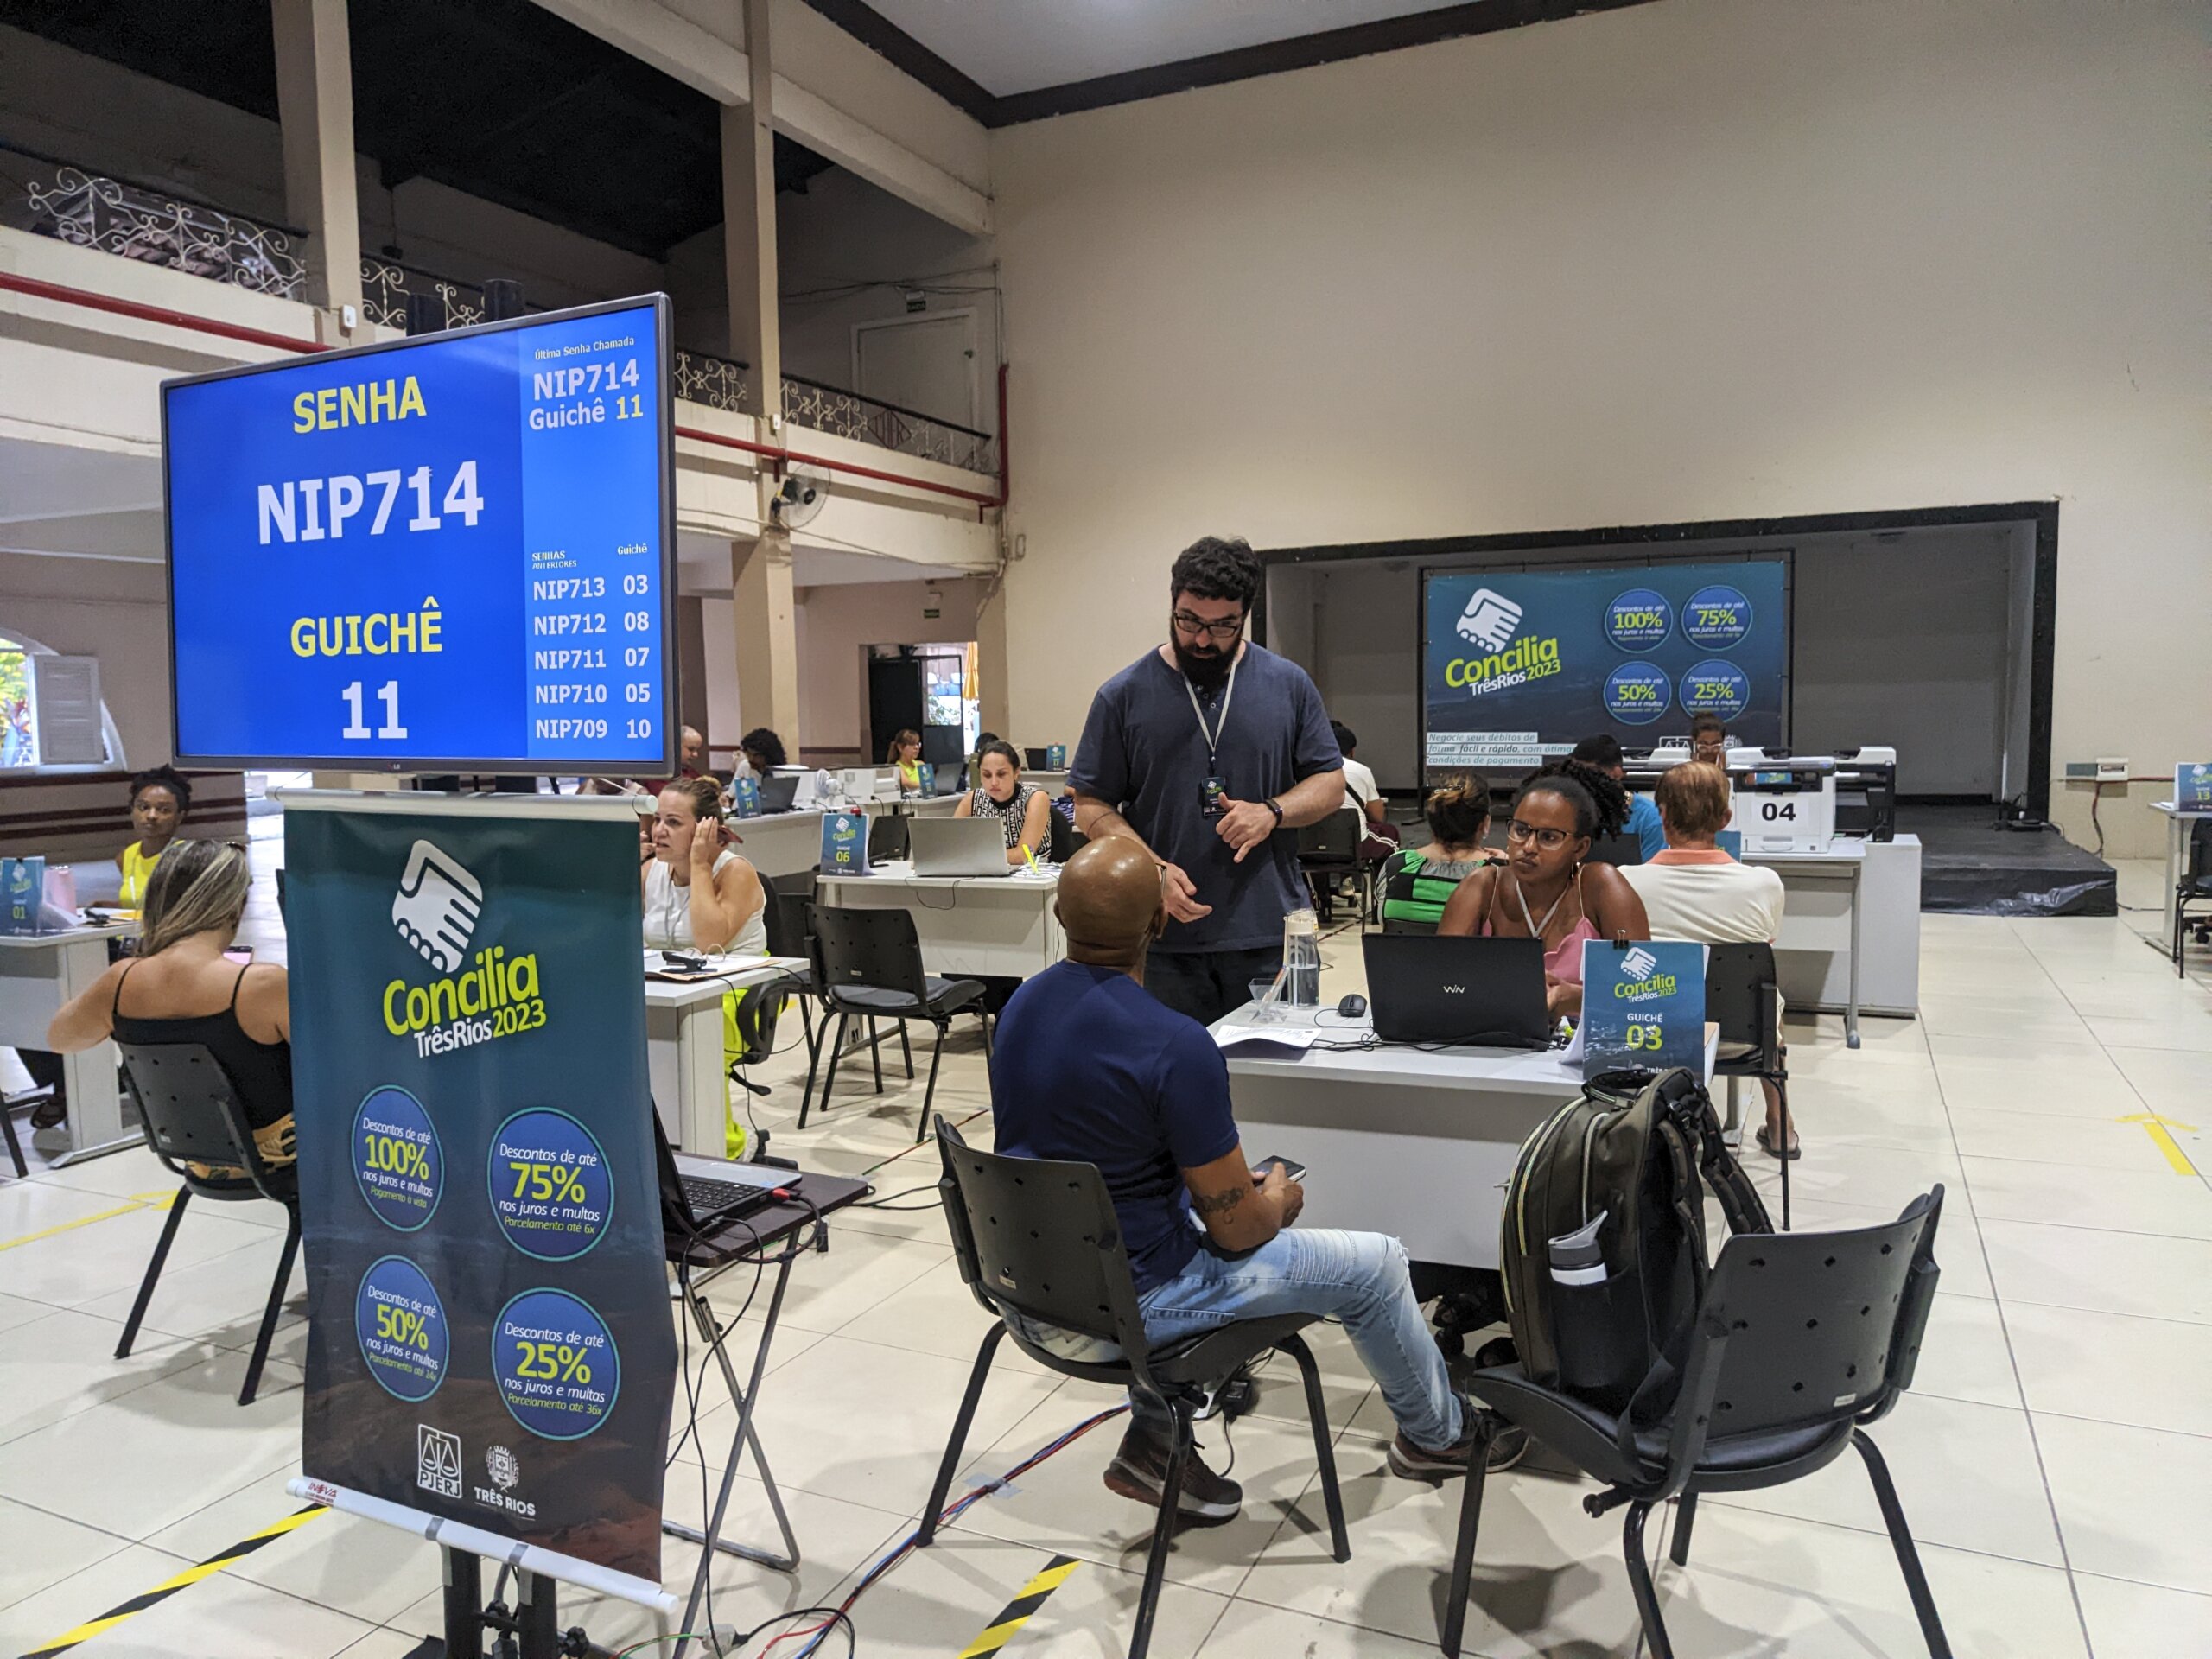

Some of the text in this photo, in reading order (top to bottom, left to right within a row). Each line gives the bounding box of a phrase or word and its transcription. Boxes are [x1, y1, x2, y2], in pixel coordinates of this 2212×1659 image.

[535, 335, 634, 360] Última Senha Chamada
[533, 359, 639, 401] NIP714
[292, 375, 427, 433] SENHA
[529, 394, 644, 430] Guichê 11
[257, 460, 484, 544] NIP714
[531, 550, 566, 562] SENHAS
[617, 543, 648, 556] Guichê
[531, 560, 577, 570] ANTERIORES
[533, 576, 606, 601] NIP713
[623, 574, 648, 595] 03
[290, 596, 442, 657] GUICHÊ
[534, 613, 607, 636] NIP712
[624, 611, 650, 632] 08
[1614, 612, 1662, 629] 100%
[1697, 608, 1737, 626] 75%
[534, 649, 607, 670] NIP711
[624, 647, 650, 667] 07
[1445, 635, 1558, 688] Concilia
[535, 684, 607, 704] NIP710
[625, 683, 651, 702] 05
[1618, 684, 1656, 701] 50%
[1694, 683, 1734, 700] 25%
[341, 681, 408, 739] 11
[536, 719, 607, 739] NIP709
[626, 719, 652, 739] 10
[1429, 733, 1464, 743] Negocie
[1523, 733, 1535, 741] de
[1459, 744, 1479, 754] fácil
[1761, 803, 1796, 822] 04
[836, 851, 850, 862] 06
[383, 945, 539, 1036] Concilia
[1614, 973, 1675, 999] Concilia
[1627, 1013, 1663, 1023] GUICHÊ
[1626, 1024, 1663, 1051] 03
[363, 1117, 431, 1145] Descontos de até
[365, 1135, 429, 1180] 100%
[499, 1143, 597, 1166] Descontos de até
[363, 1170, 433, 1198] nos juros e multas
[370, 1185, 406, 1203] Pagamento
[510, 1161, 586, 1204] 75%
[499, 1199, 600, 1222] nos juros e multas
[505, 1216, 594, 1234] Parcelamento até 6x
[367, 1285, 437, 1318] Descontos de até
[377, 1304, 429, 1351] 50%
[505, 1322, 604, 1348] Descontos de até
[366, 1338, 439, 1370] nos juros e multas
[369, 1351, 412, 1373] Parcelamento
[516, 1341, 591, 1384] 25%
[505, 1378, 606, 1402] nos juros e multas
[507, 1393, 602, 1416] Parcelamento até 36x
[419, 1470, 461, 1497] PJERJ
[474, 1486, 536, 1516] TRÊS RIOS
